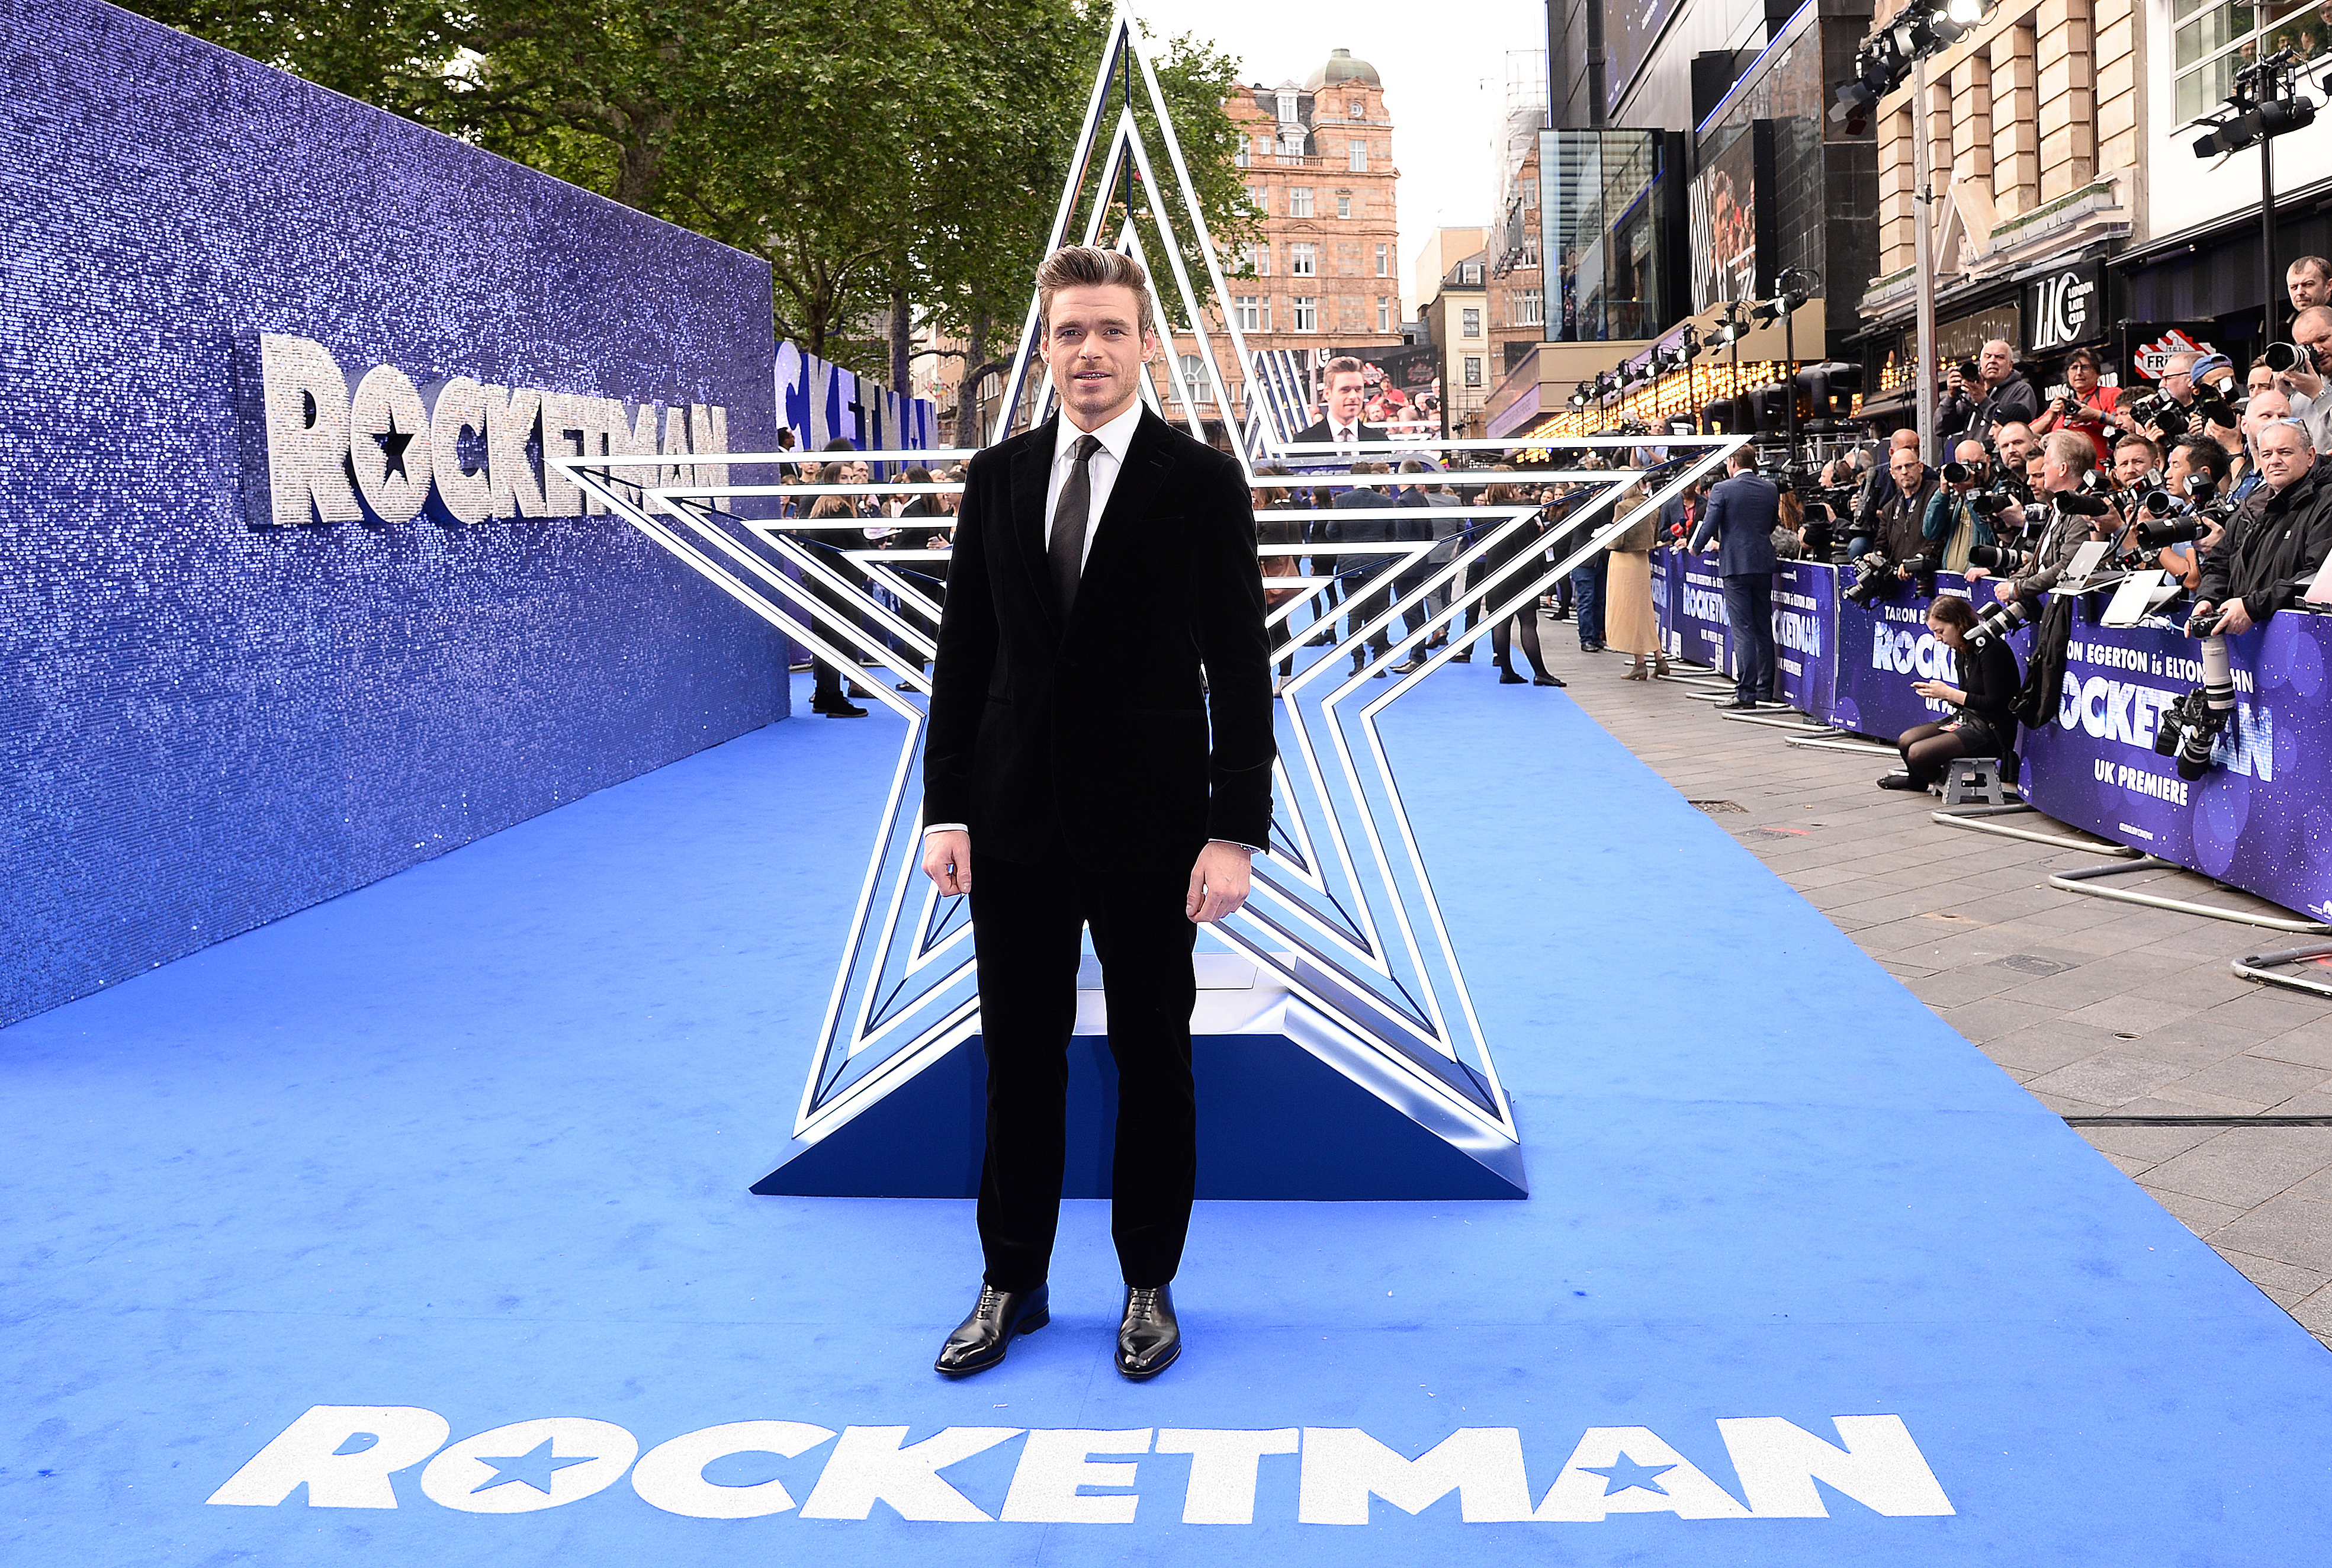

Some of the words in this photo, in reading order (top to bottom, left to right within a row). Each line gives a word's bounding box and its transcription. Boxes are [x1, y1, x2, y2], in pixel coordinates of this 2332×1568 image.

[2067, 281, 2093, 299] LONDON
[2068, 297, 2084, 312] LATE
[2068, 310, 2085, 324] CLUB
[260, 333, 731, 525] ROCKETMAN
[775, 341, 940, 481] CKETMAN
[1683, 583, 1731, 627] ROCKETM
[1885, 606, 1917, 623] TARON
[1771, 609, 1820, 658] CKETMAN
[2087, 644, 2147, 673] EGERTON
[2151, 653, 2163, 676] is
[2166, 656, 2206, 683] ELTON
[2230, 668, 2253, 693] HN
[1925, 697, 1940, 711] UK
[2095, 759, 2115, 784] UK
[2118, 765, 2189, 807] PREMIERE
[204, 1405, 1957, 1525] ROCKETMAN
